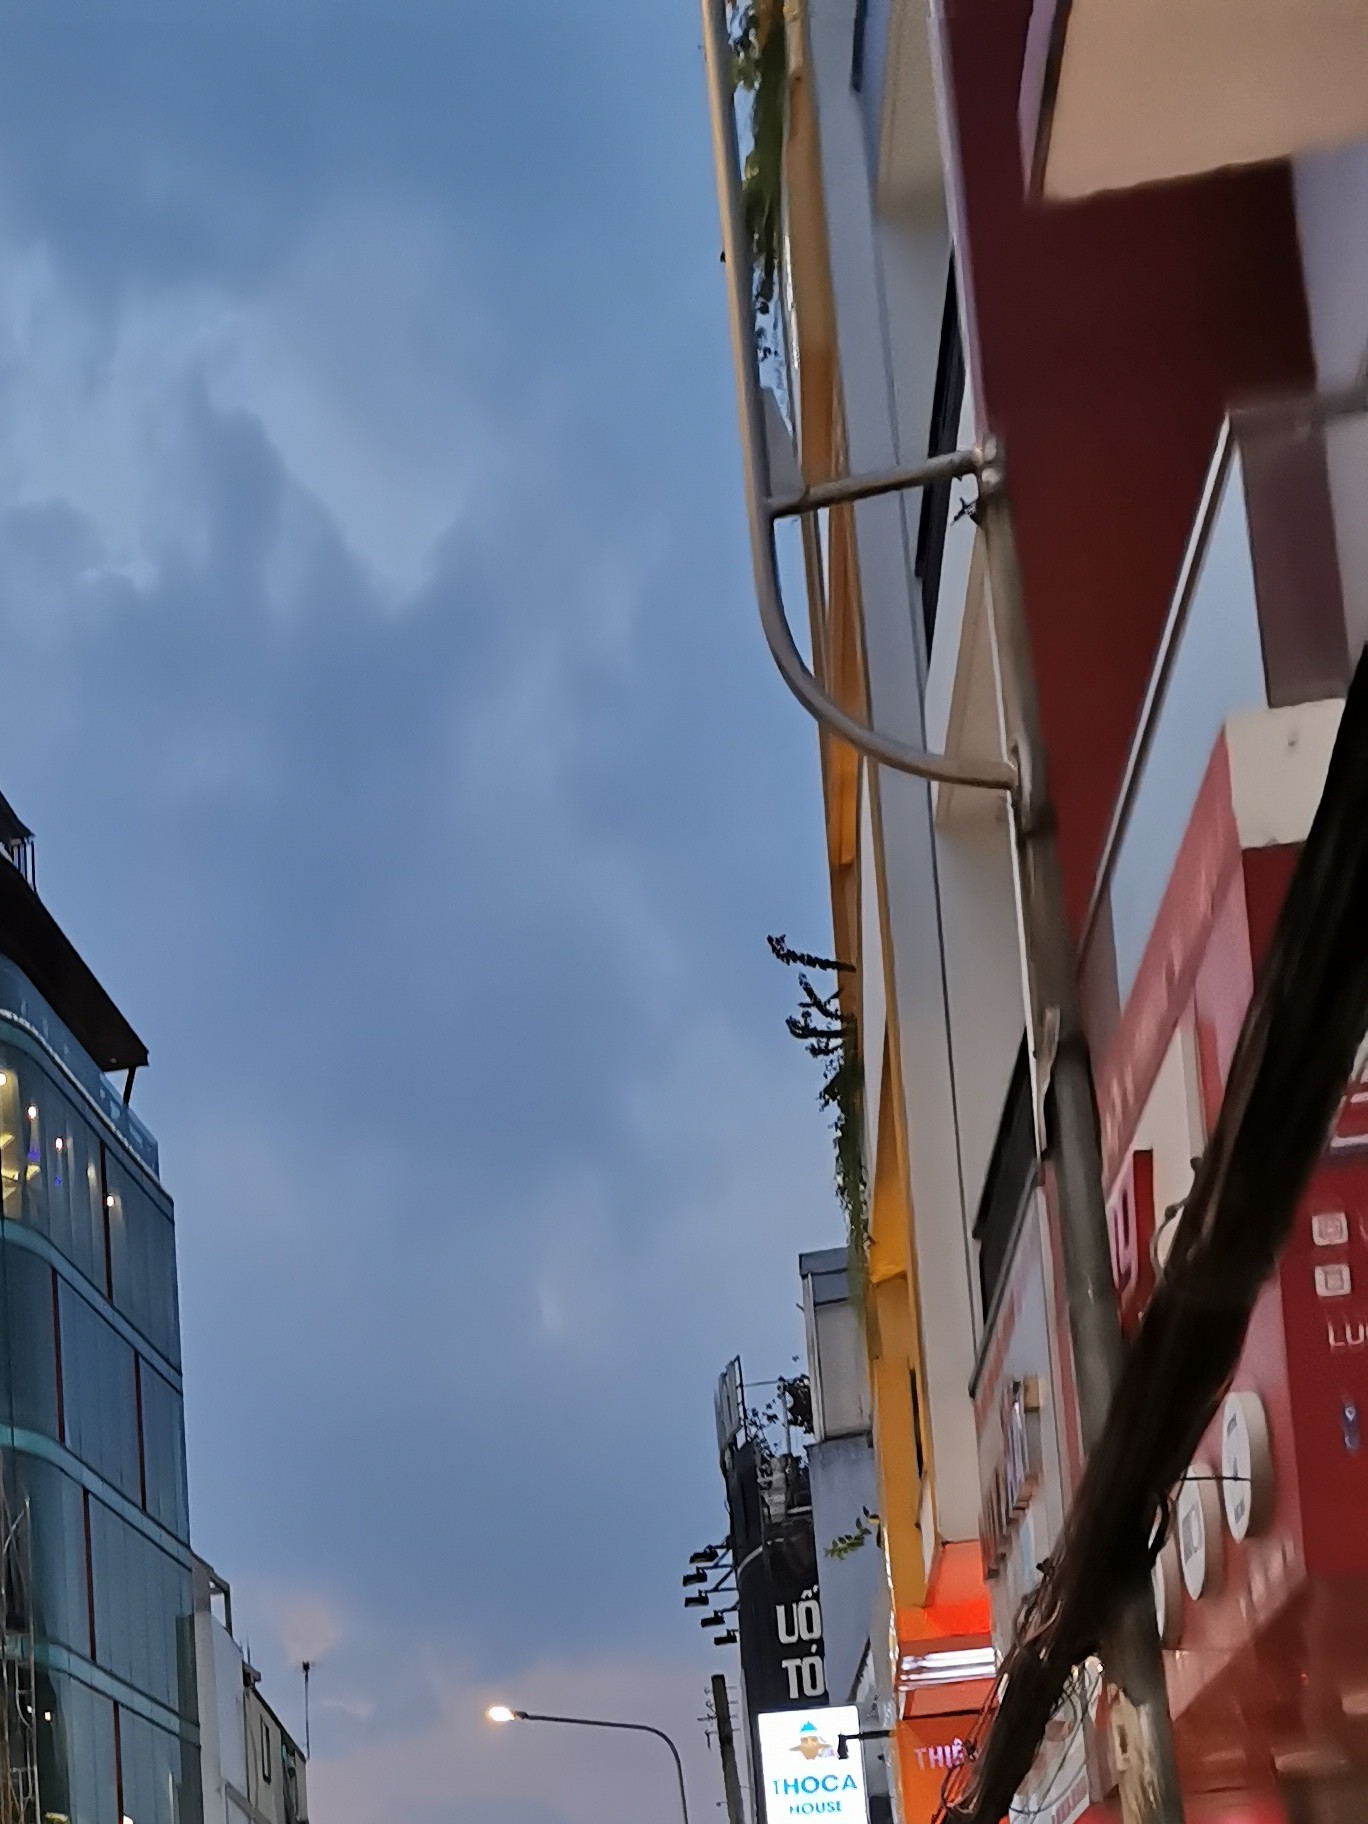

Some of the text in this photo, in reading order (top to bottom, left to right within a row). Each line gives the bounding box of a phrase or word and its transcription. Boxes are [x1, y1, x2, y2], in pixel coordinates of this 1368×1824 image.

[1329, 1322, 1368, 1348] LU
[914, 1737, 965, 1770] THIÊ
[772, 1774, 857, 1797] THOCA
[789, 1801, 842, 1816] HOUSE
